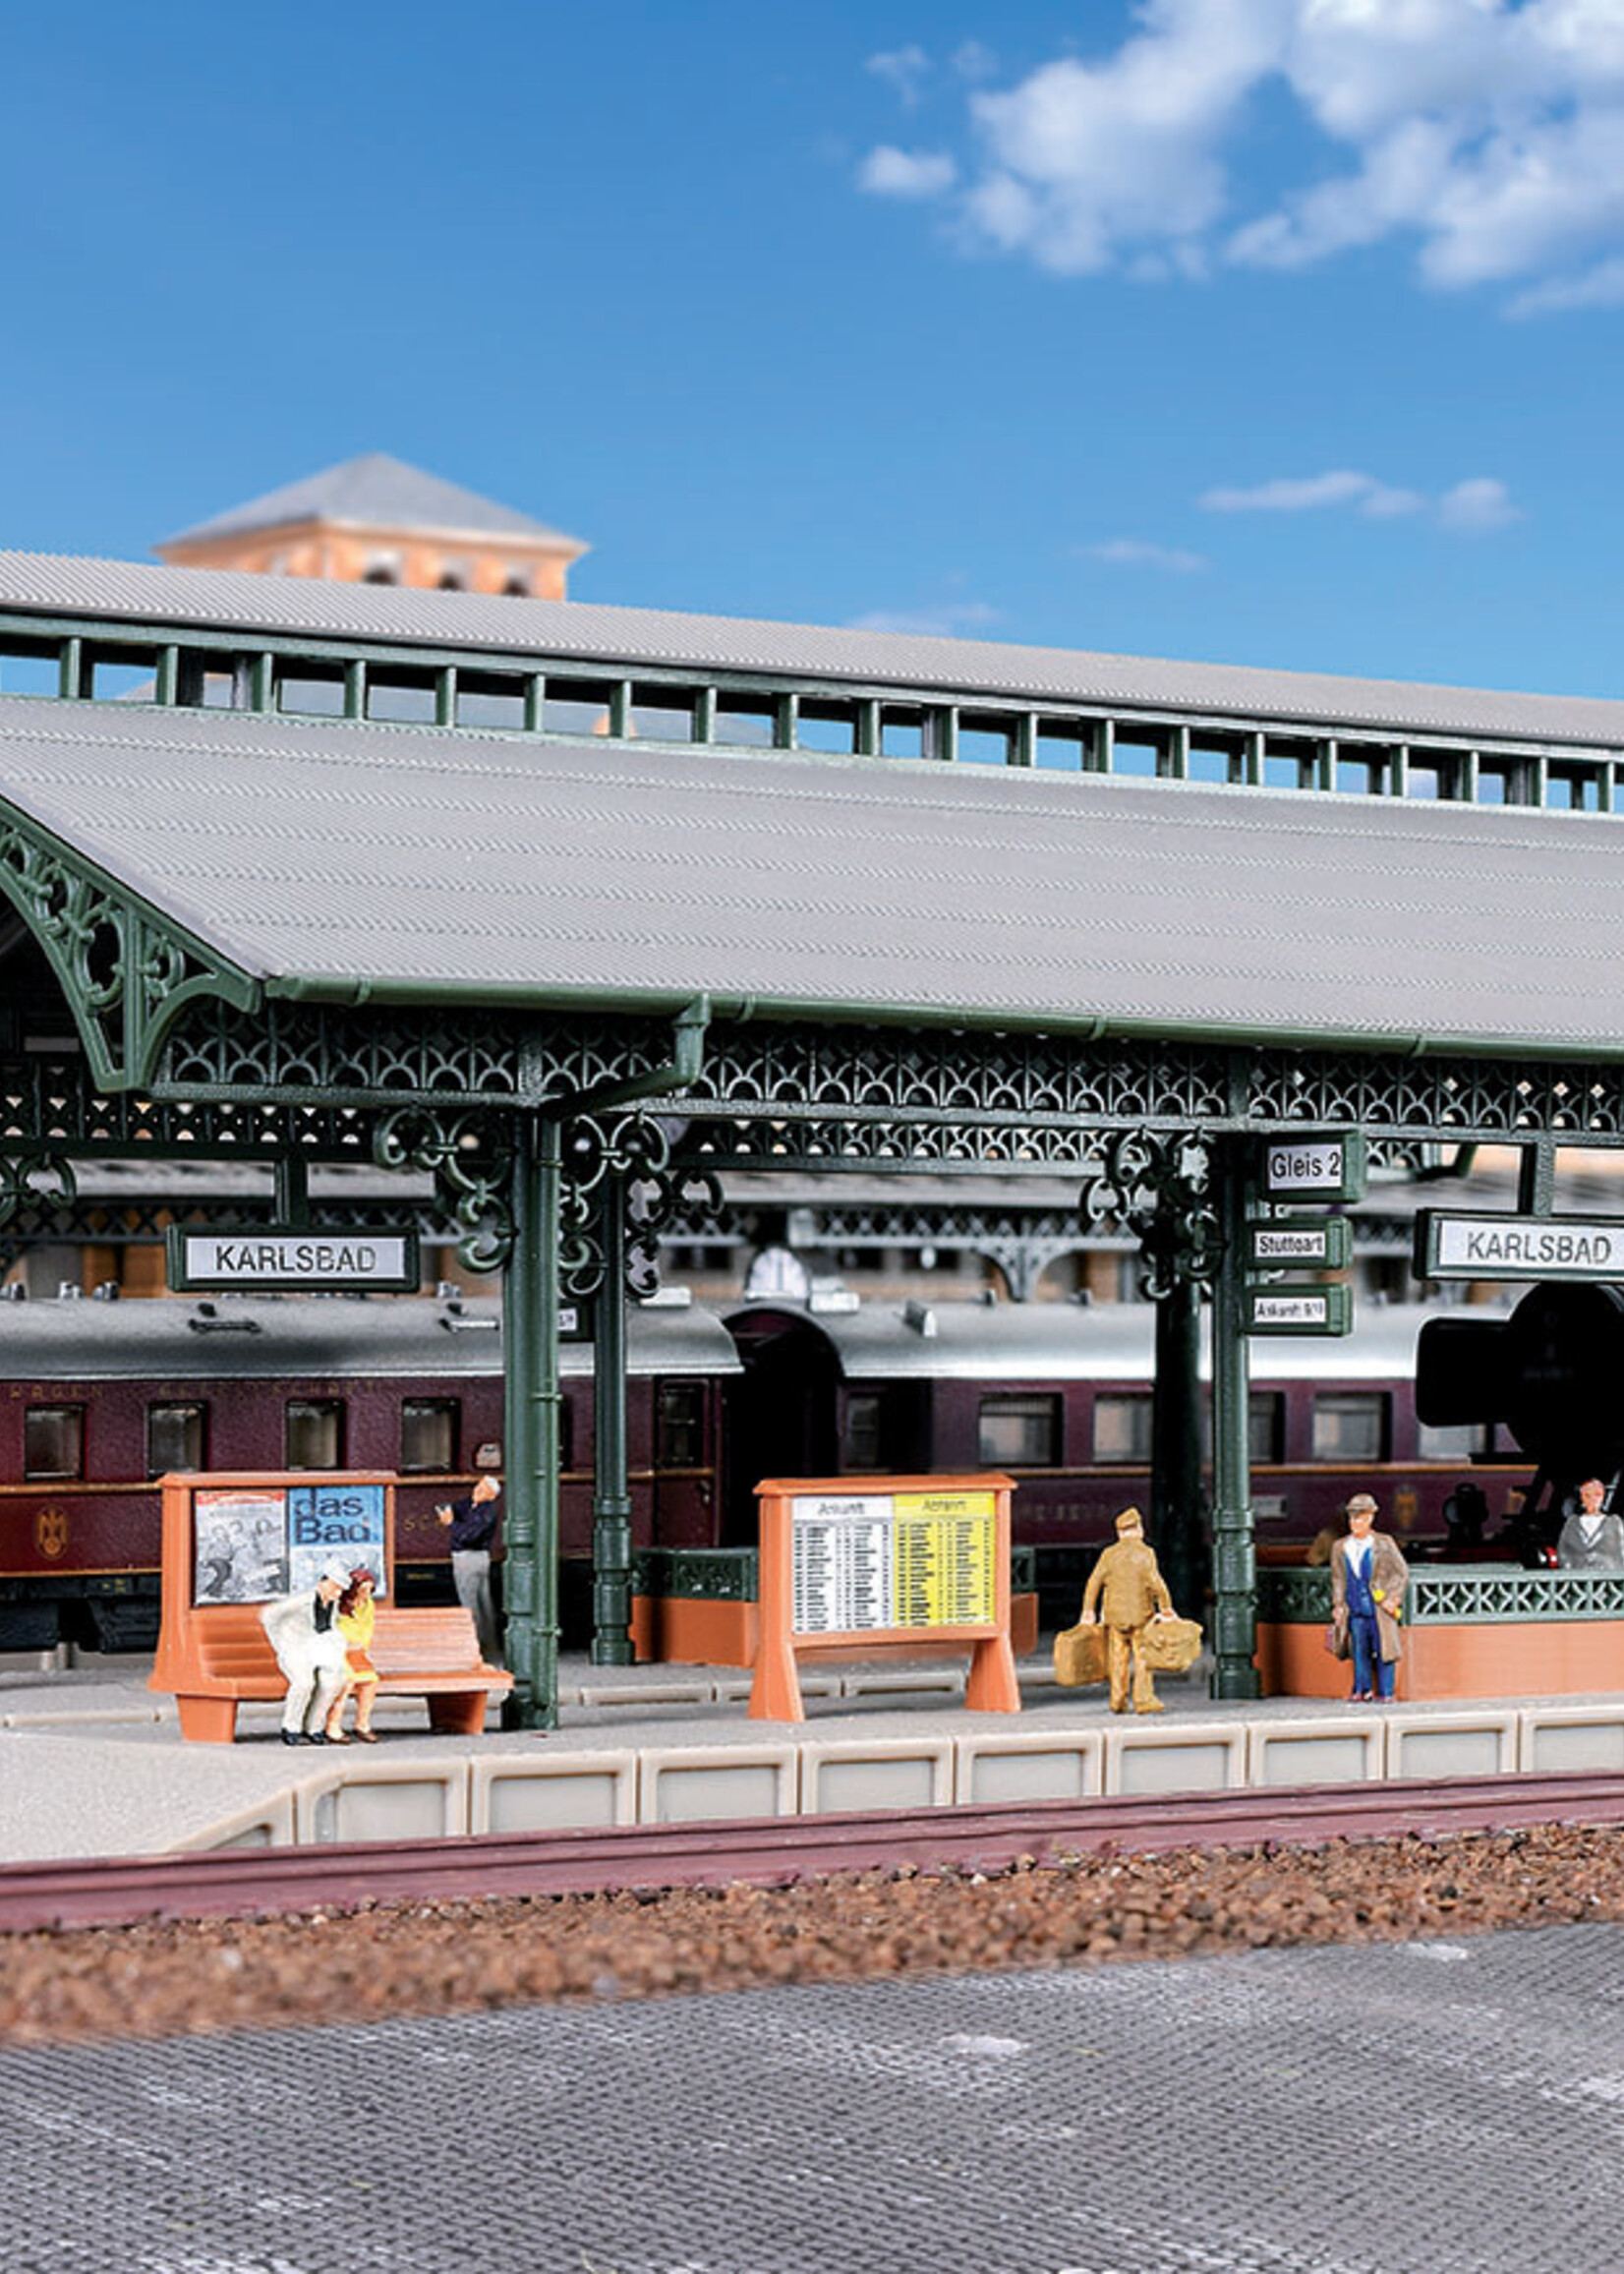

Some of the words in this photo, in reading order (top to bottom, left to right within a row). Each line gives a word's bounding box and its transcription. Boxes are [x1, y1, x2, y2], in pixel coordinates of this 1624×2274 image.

[1271, 1152, 1323, 1180] Gleis
[1328, 1151, 1342, 1177] 2
[215, 1245, 377, 1272] KARLSBAD
[1467, 1232, 1612, 1264] KARLSBAD
[294, 1486, 364, 1518] das
